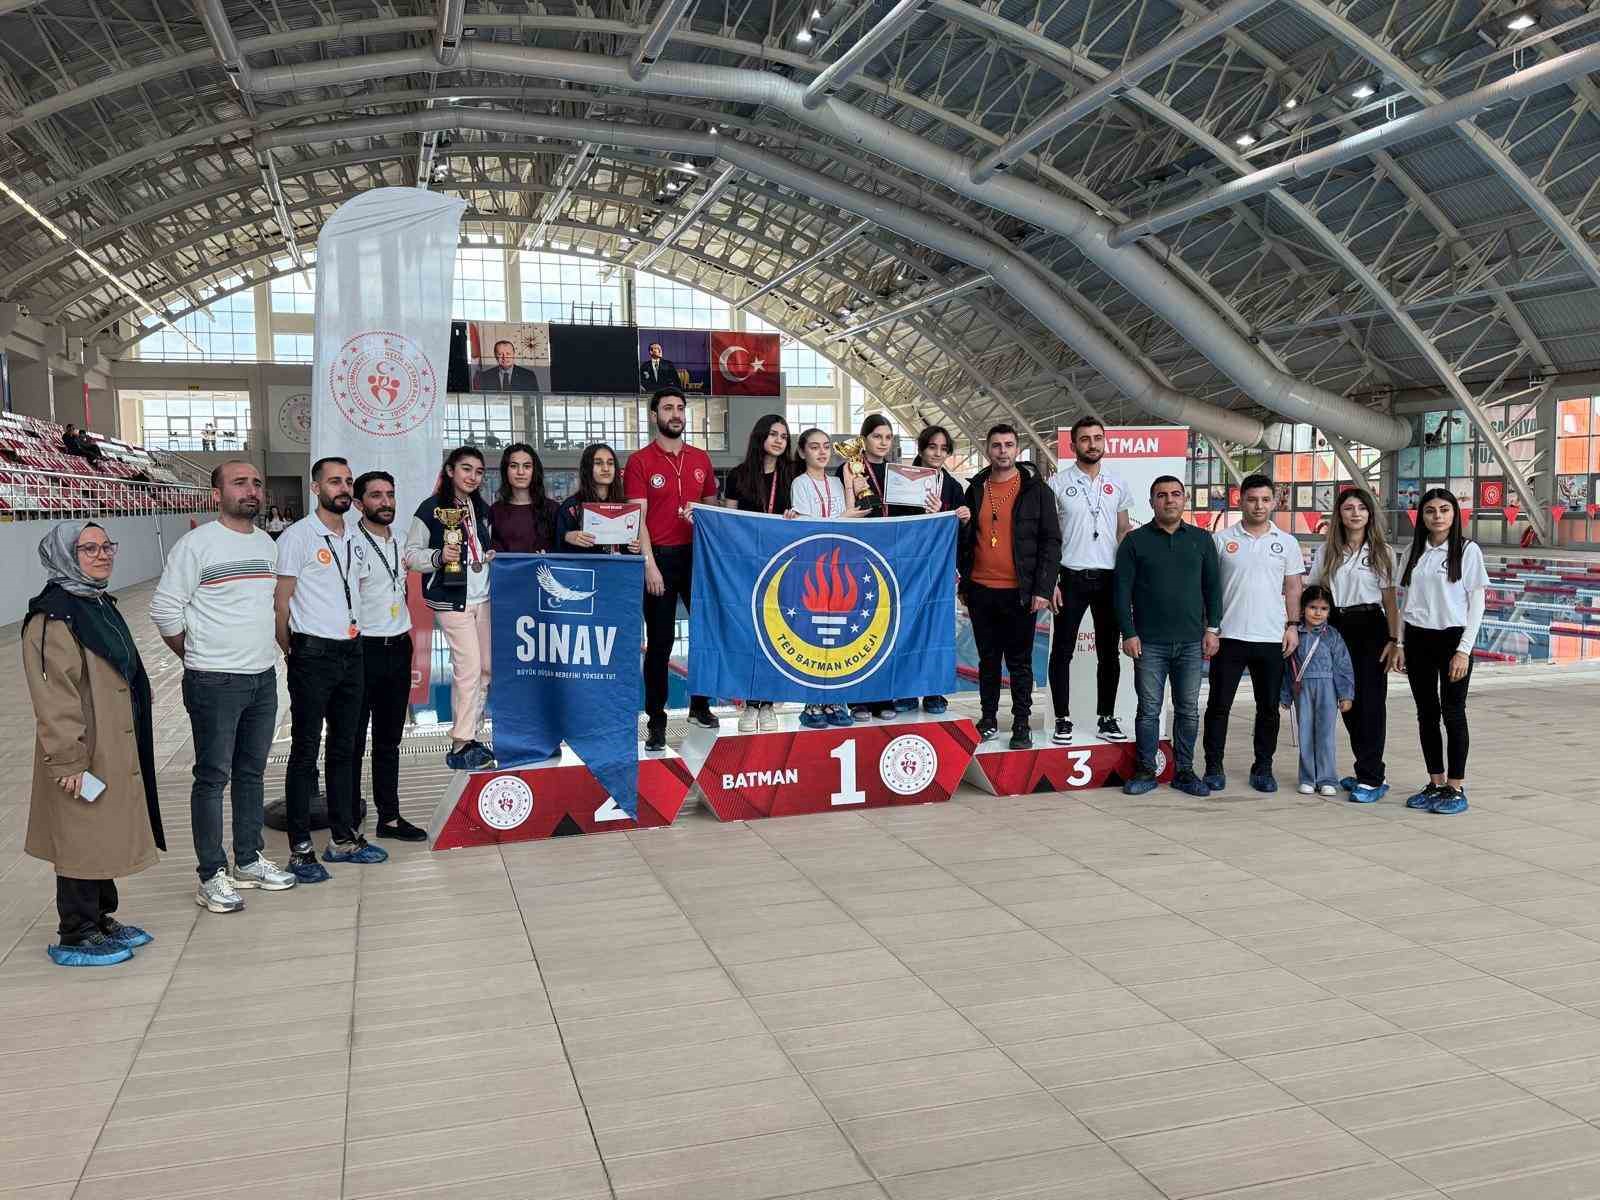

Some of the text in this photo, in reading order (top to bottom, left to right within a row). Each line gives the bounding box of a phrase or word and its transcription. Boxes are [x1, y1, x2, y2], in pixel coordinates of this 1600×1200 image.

[1103, 437, 1159, 454] ATMAN
[516, 615, 617, 666] SINAV
[777, 633, 796, 655] TED
[795, 653, 842, 672] BATMAN
[722, 769, 798, 790] BATMAN
[830, 739, 866, 806] 1
[1066, 750, 1093, 787] 3
